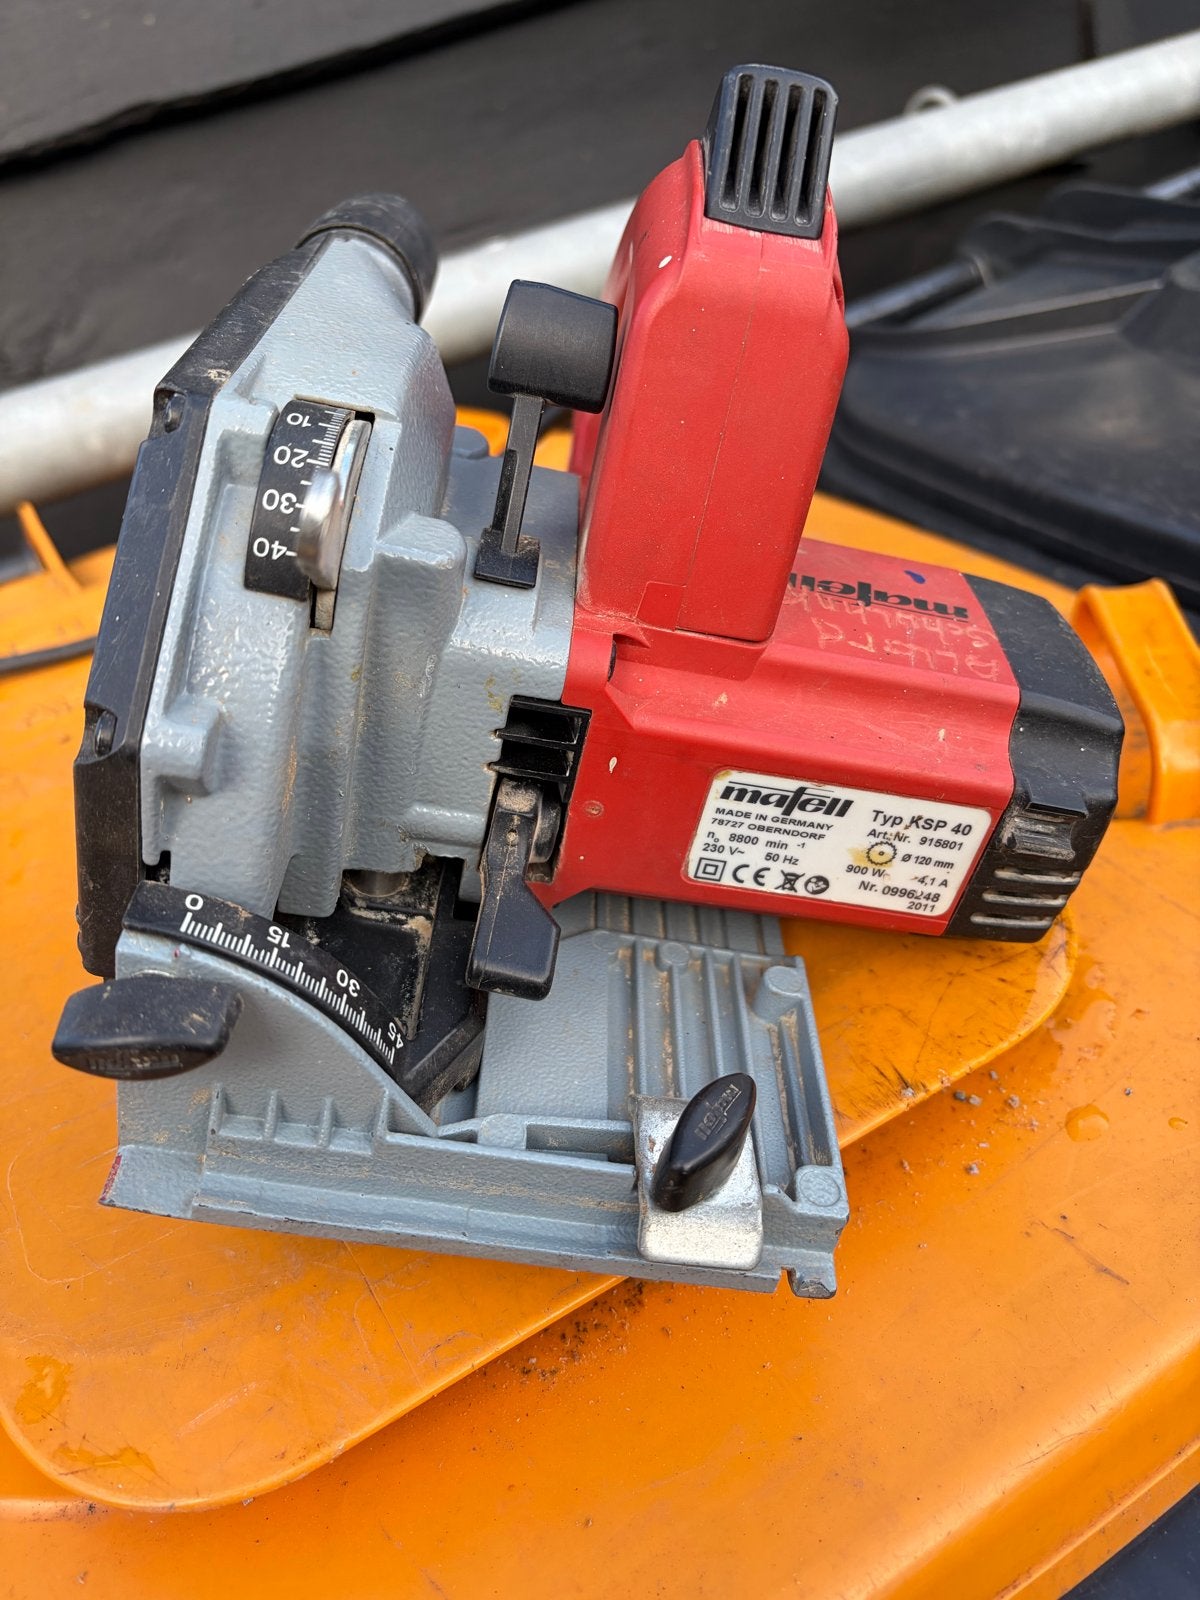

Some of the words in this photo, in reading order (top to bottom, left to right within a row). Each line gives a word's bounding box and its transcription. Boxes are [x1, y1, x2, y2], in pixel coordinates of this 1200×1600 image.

[286, 412, 312, 428] 10
[273, 445, 310, 469] 20
[262, 488, 297, 514] 30
[252, 537, 288, 560] 40
[719, 782, 855, 818] mafell
[710, 817, 745, 829] 78727
[747, 823, 827, 841] OBERNDORF
[715, 807, 753, 819] MADE
[754, 813, 768, 821] IN
[770, 816, 834, 831] GERMANY
[872, 809, 904, 828] Typ
[909, 815, 948, 832] KSP
[950, 823, 973, 836] 40
[728, 833, 759, 846] 8800
[765, 840, 789, 850] min
[919, 836, 964, 851] 915801
[702, 842, 725, 854] 230
[764, 852, 780, 863] 50
[782, 855, 799, 866] Hz
[914, 855, 932, 866] 120
[933, 860, 954, 870] mm
[845, 864, 869, 875] 900
[871, 868, 886, 878] W
[938, 879, 948, 888] A
[184, 893, 204, 911] 0
[858, 880, 878, 892] Nr.
[881, 885, 941, 903] 0996248
[907, 901, 936, 913] 2011
[266, 925, 291, 949] 15
[336, 968, 360, 997] 30
[387, 1021, 404, 1050] 45
